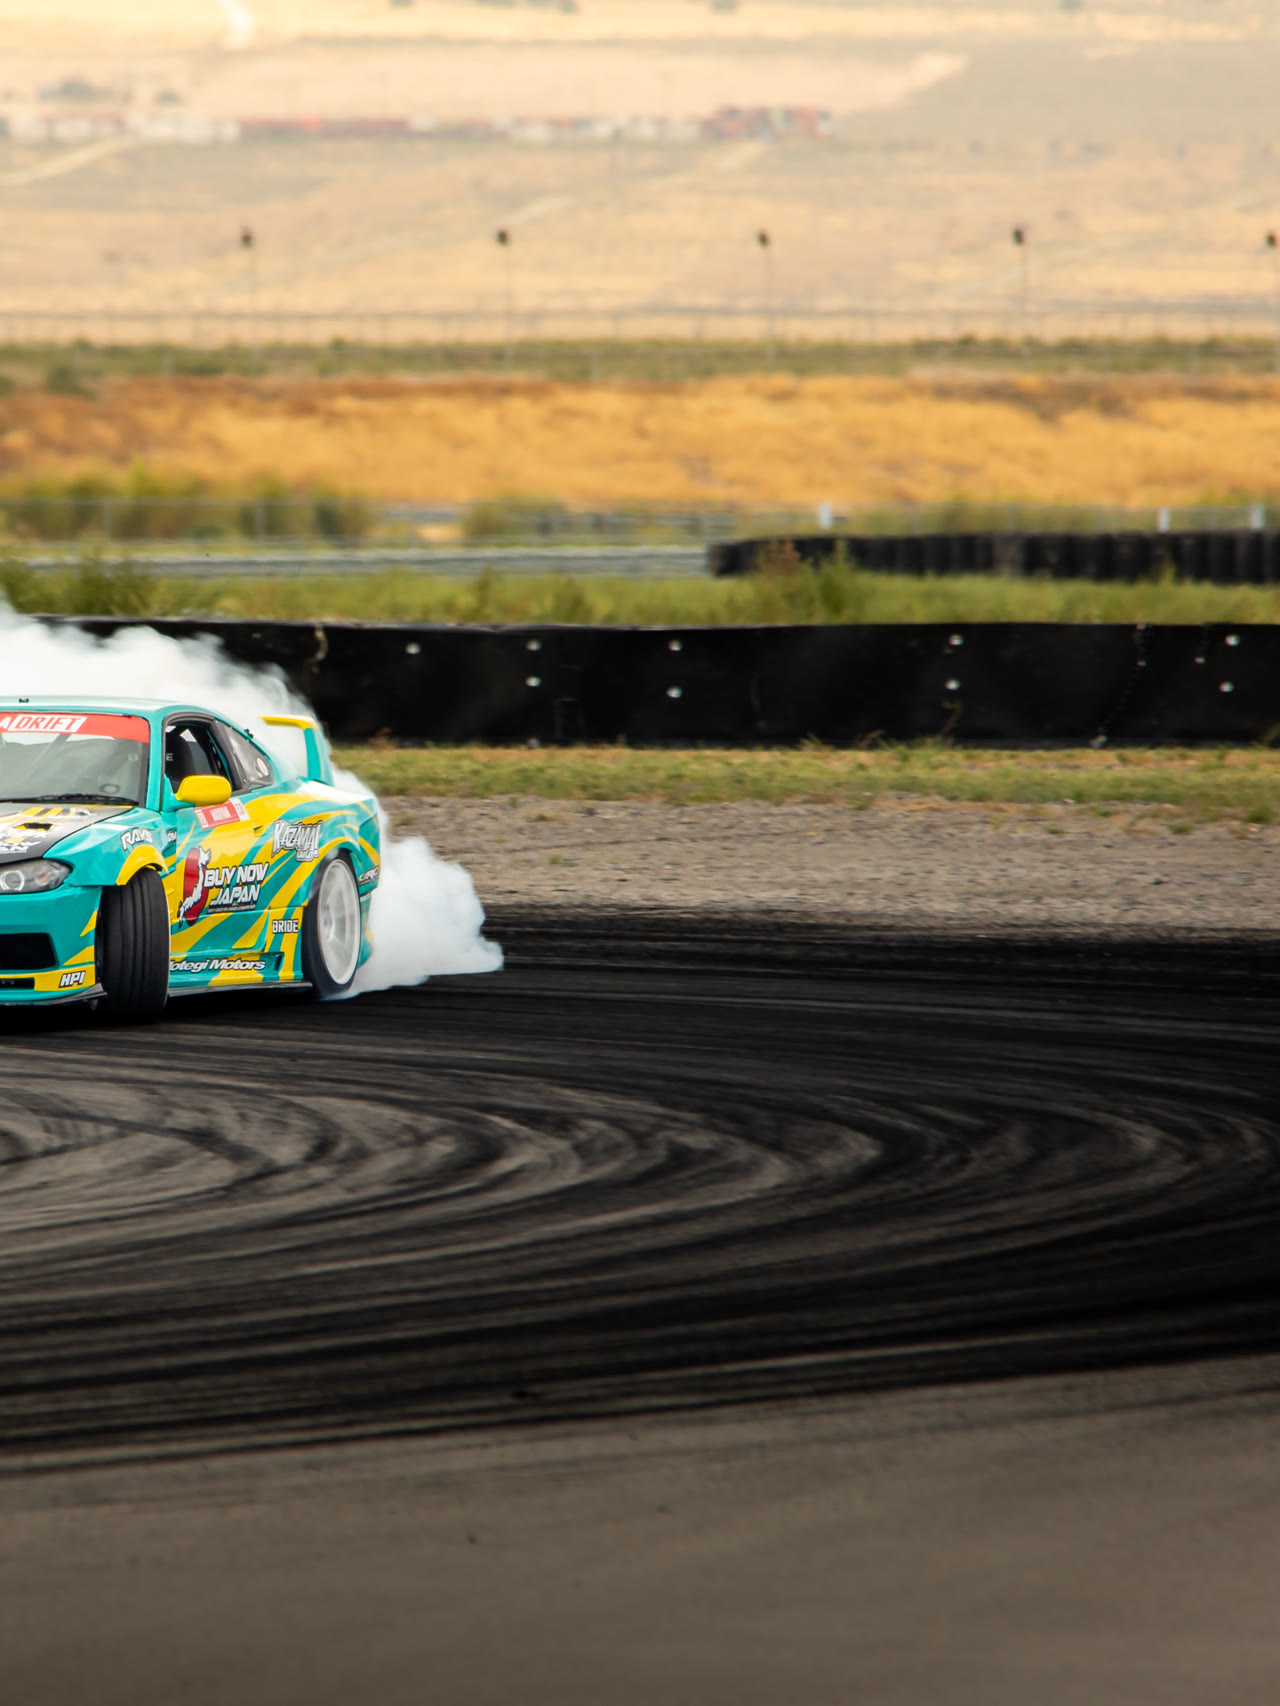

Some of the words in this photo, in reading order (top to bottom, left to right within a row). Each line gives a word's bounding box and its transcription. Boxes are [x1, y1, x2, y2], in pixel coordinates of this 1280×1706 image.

[10, 715, 85, 732] DRIFT
[120, 828, 153, 850] RAYS
[204, 866, 237, 888] BUY
[236, 862, 269, 884] NOW
[209, 884, 261, 906] JAPAN
[272, 919, 299, 934] BRIDE
[208, 959, 266, 971] Motors
[59, 970, 86, 988] HPI
